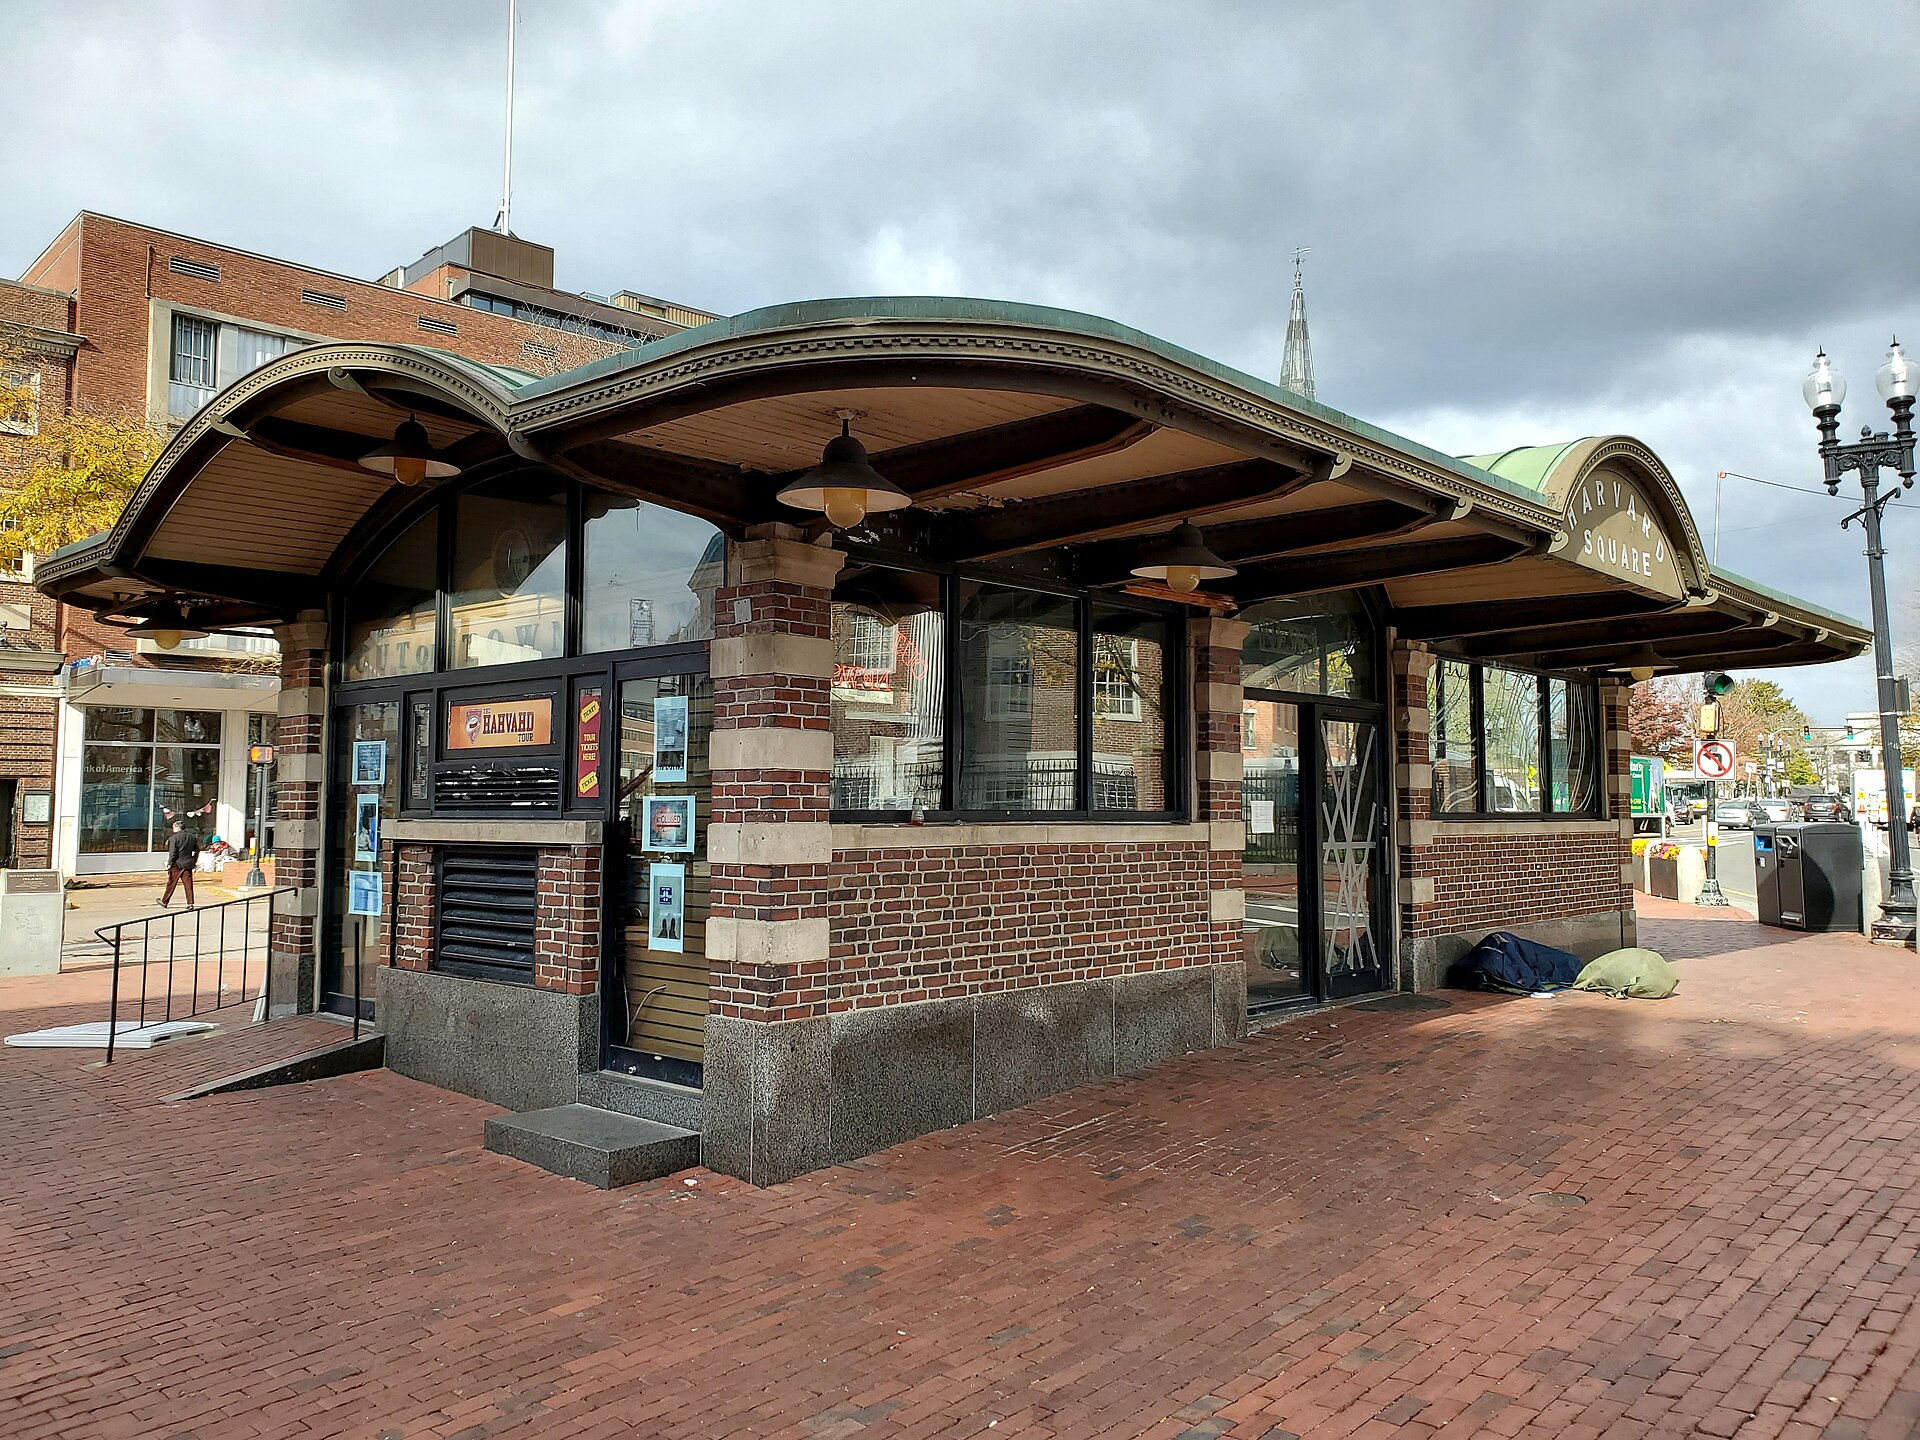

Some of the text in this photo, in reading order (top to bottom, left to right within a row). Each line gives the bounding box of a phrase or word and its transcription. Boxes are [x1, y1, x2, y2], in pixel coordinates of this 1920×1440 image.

[1567, 480, 1665, 563] HARVARD
[1583, 529, 1652, 577] SQUARE
[583, 704, 596, 717] TICKET
[483, 712, 535, 734] HAHVAHD
[518, 733, 534, 743] TOUR
[584, 734, 596, 742] TOUR
[581, 743, 598, 751] TICKETS
[95, 764, 105, 773] of
[105, 764, 143, 773] America
[581, 775, 595, 789] TICKET
